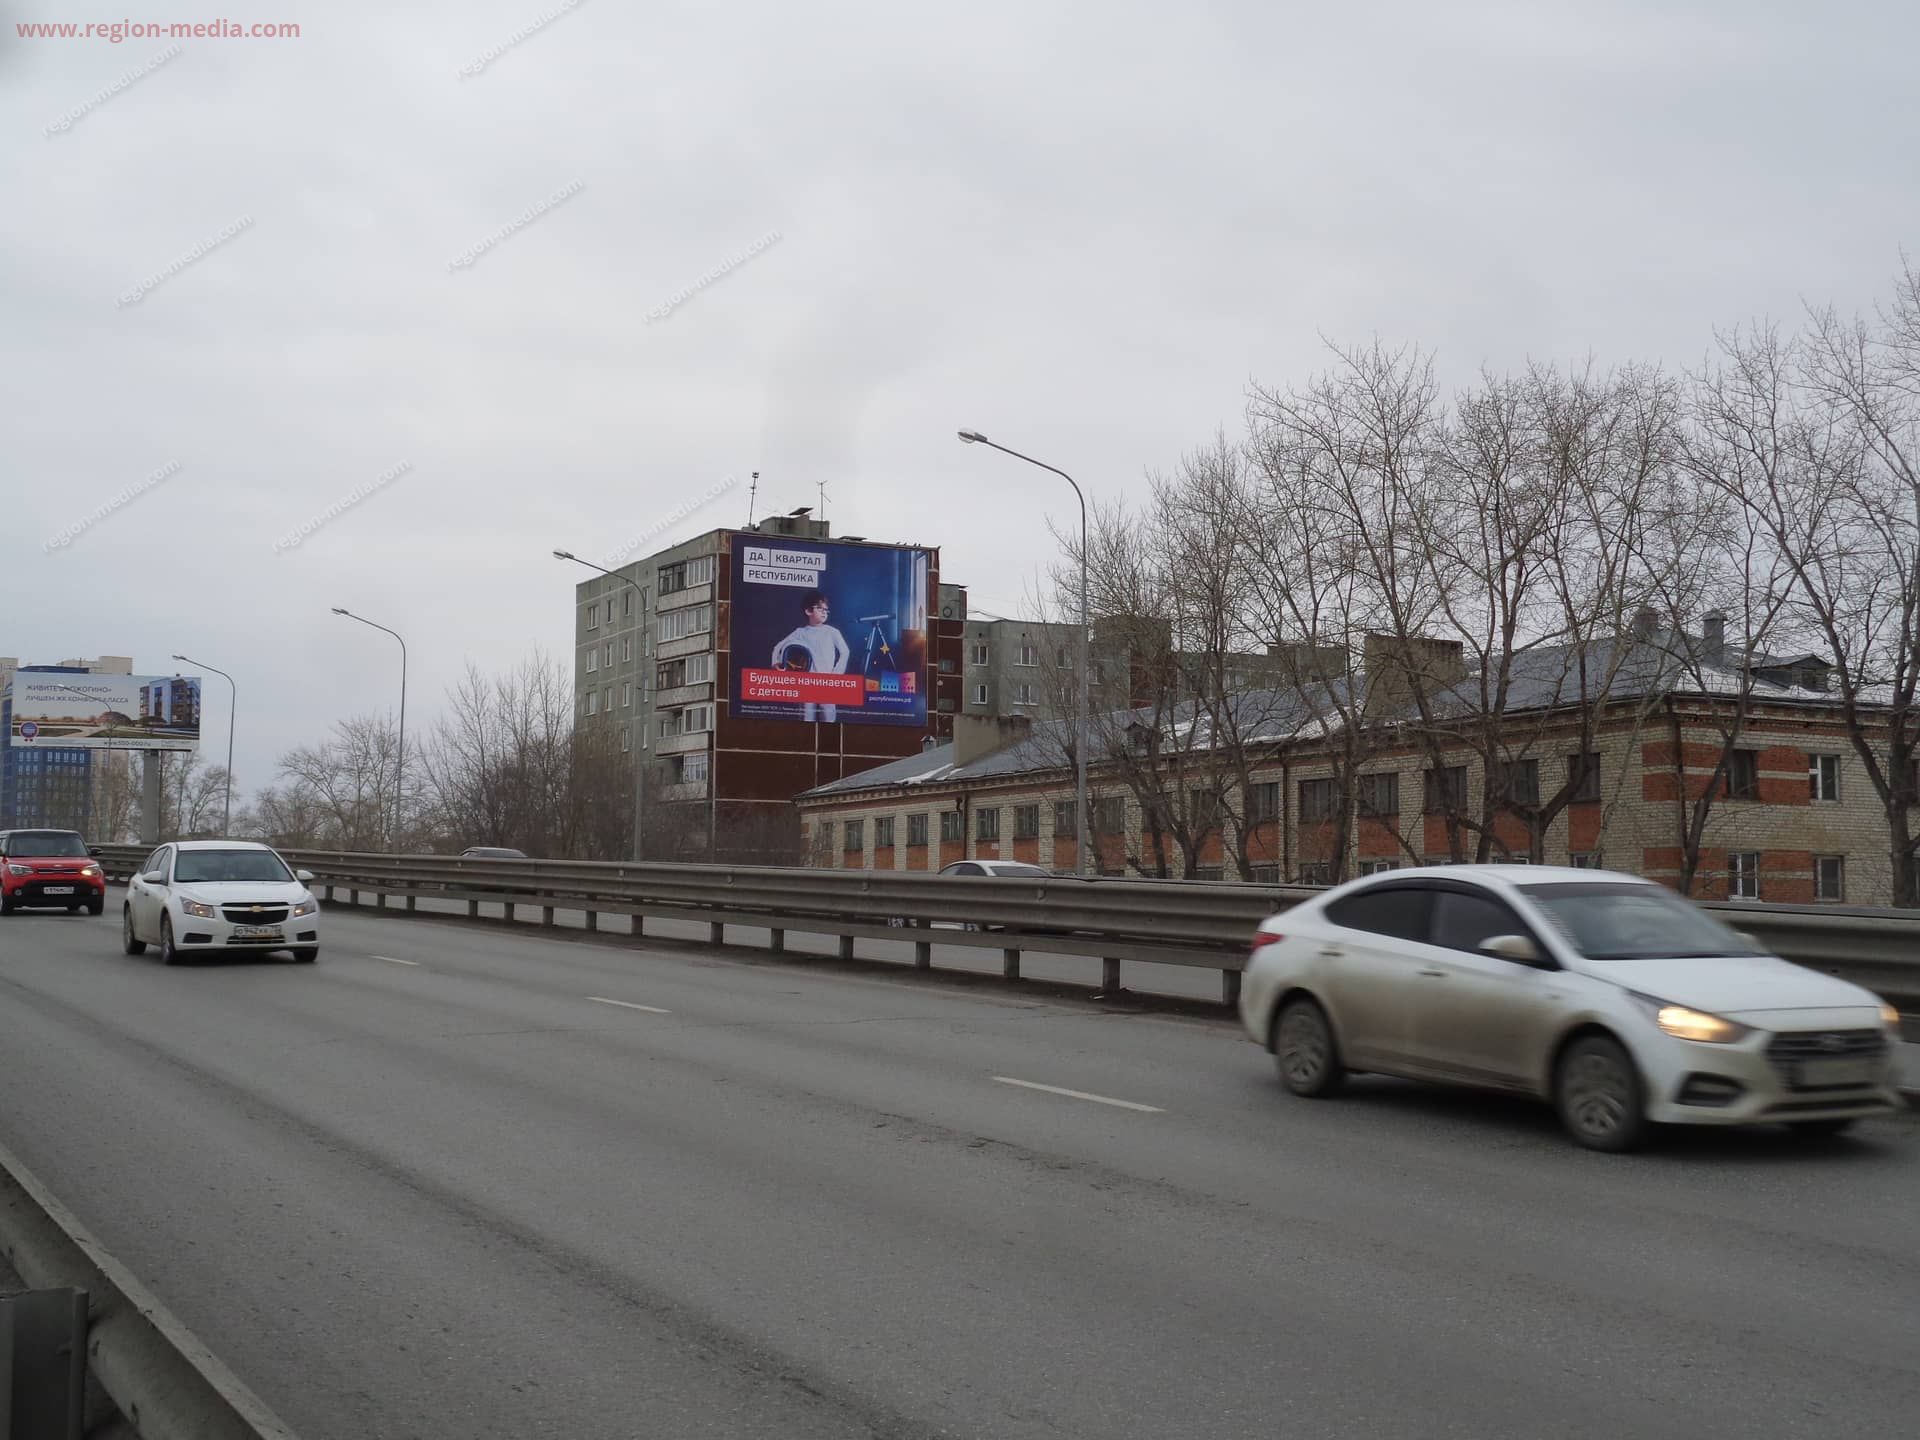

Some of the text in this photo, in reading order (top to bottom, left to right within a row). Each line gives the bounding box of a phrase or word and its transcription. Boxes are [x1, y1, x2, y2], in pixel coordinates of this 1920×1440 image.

[749, 551, 767, 563] ДА.
[775, 554, 821, 566] КВАРТАЛ
[749, 569, 814, 583] РЕСПУБЛИКА
[750, 672, 857, 689] Будущее начинается
[758, 688, 799, 698] детства
